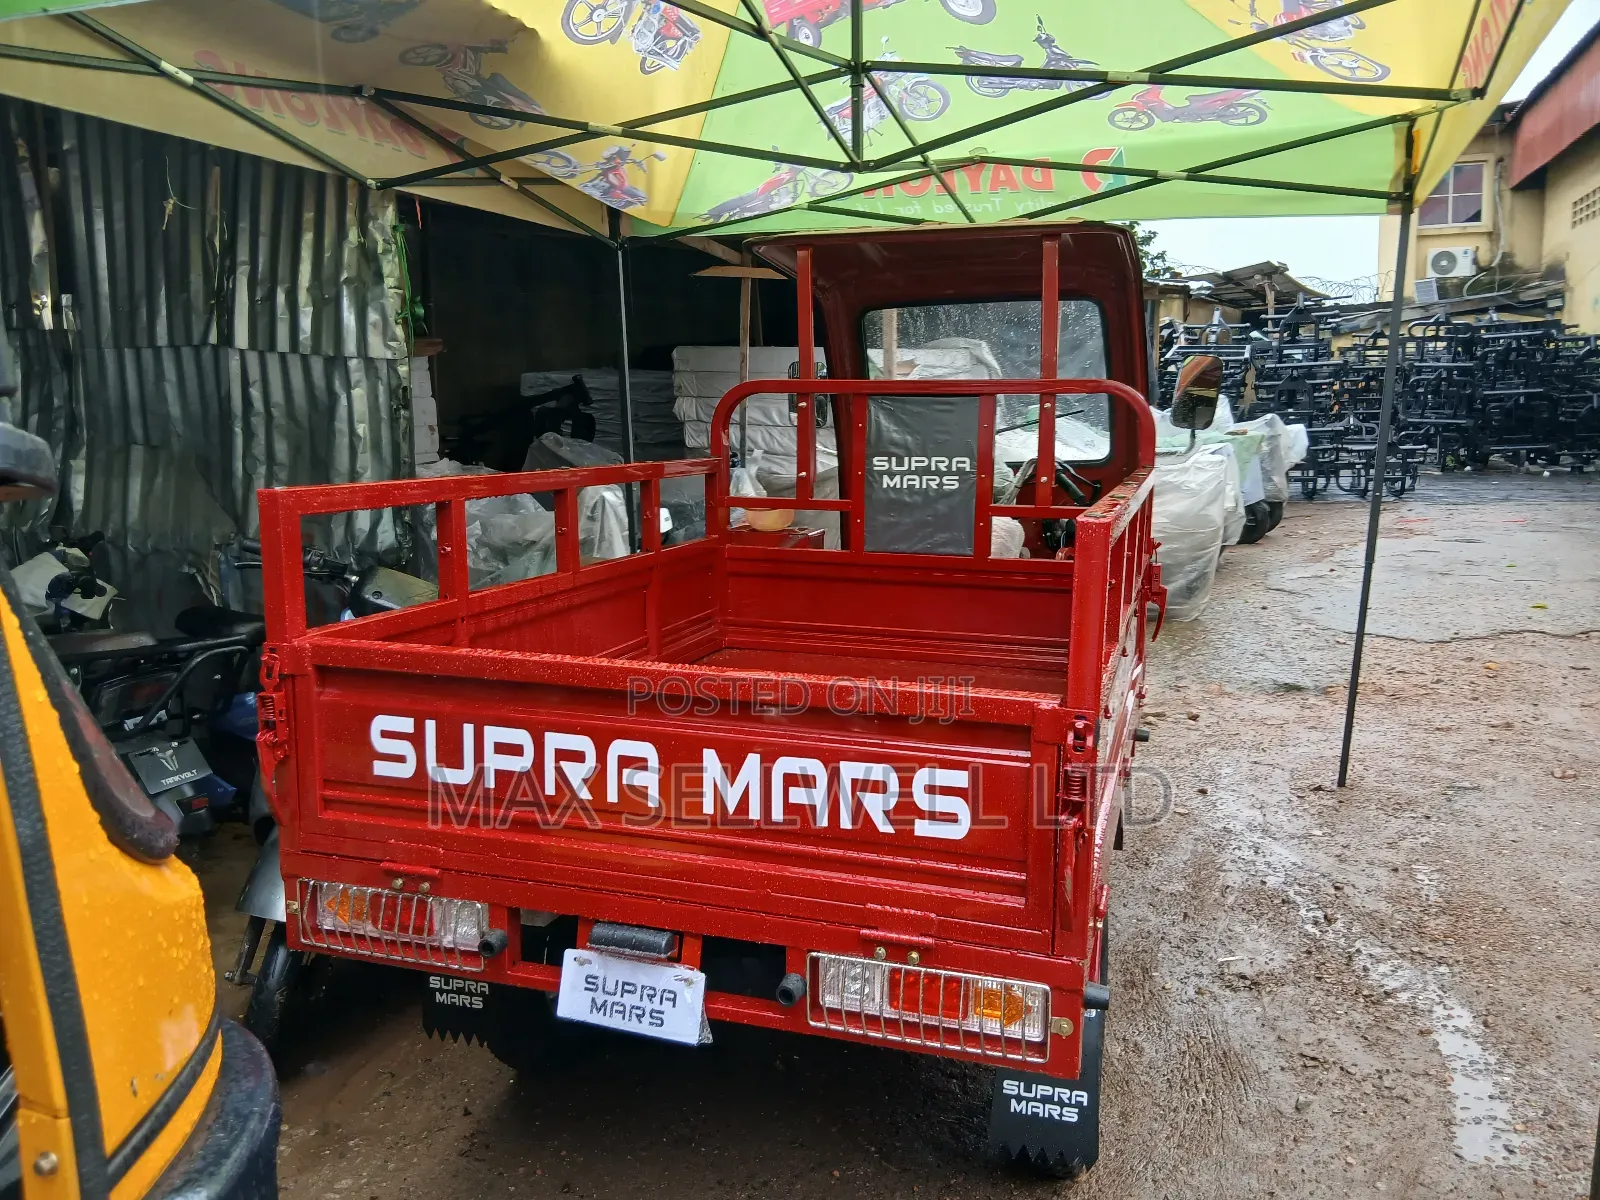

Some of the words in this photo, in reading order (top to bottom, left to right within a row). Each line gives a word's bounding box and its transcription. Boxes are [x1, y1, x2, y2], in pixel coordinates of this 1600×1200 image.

[872, 456, 971, 472] SUPRA
[882, 474, 960, 490] MARS
[160, 769, 198, 786] TANKVOLT
[370, 714, 660, 809] SUPRA
[702, 747, 971, 840] MARS
[429, 976, 489, 996] SUPRA
[584, 974, 678, 1009] SUPRA
[435, 991, 484, 1010] MARS
[590, 996, 666, 1028] MARS
[1002, 1079, 1089, 1107] SUPRA
[1010, 1098, 1079, 1123] MARS
